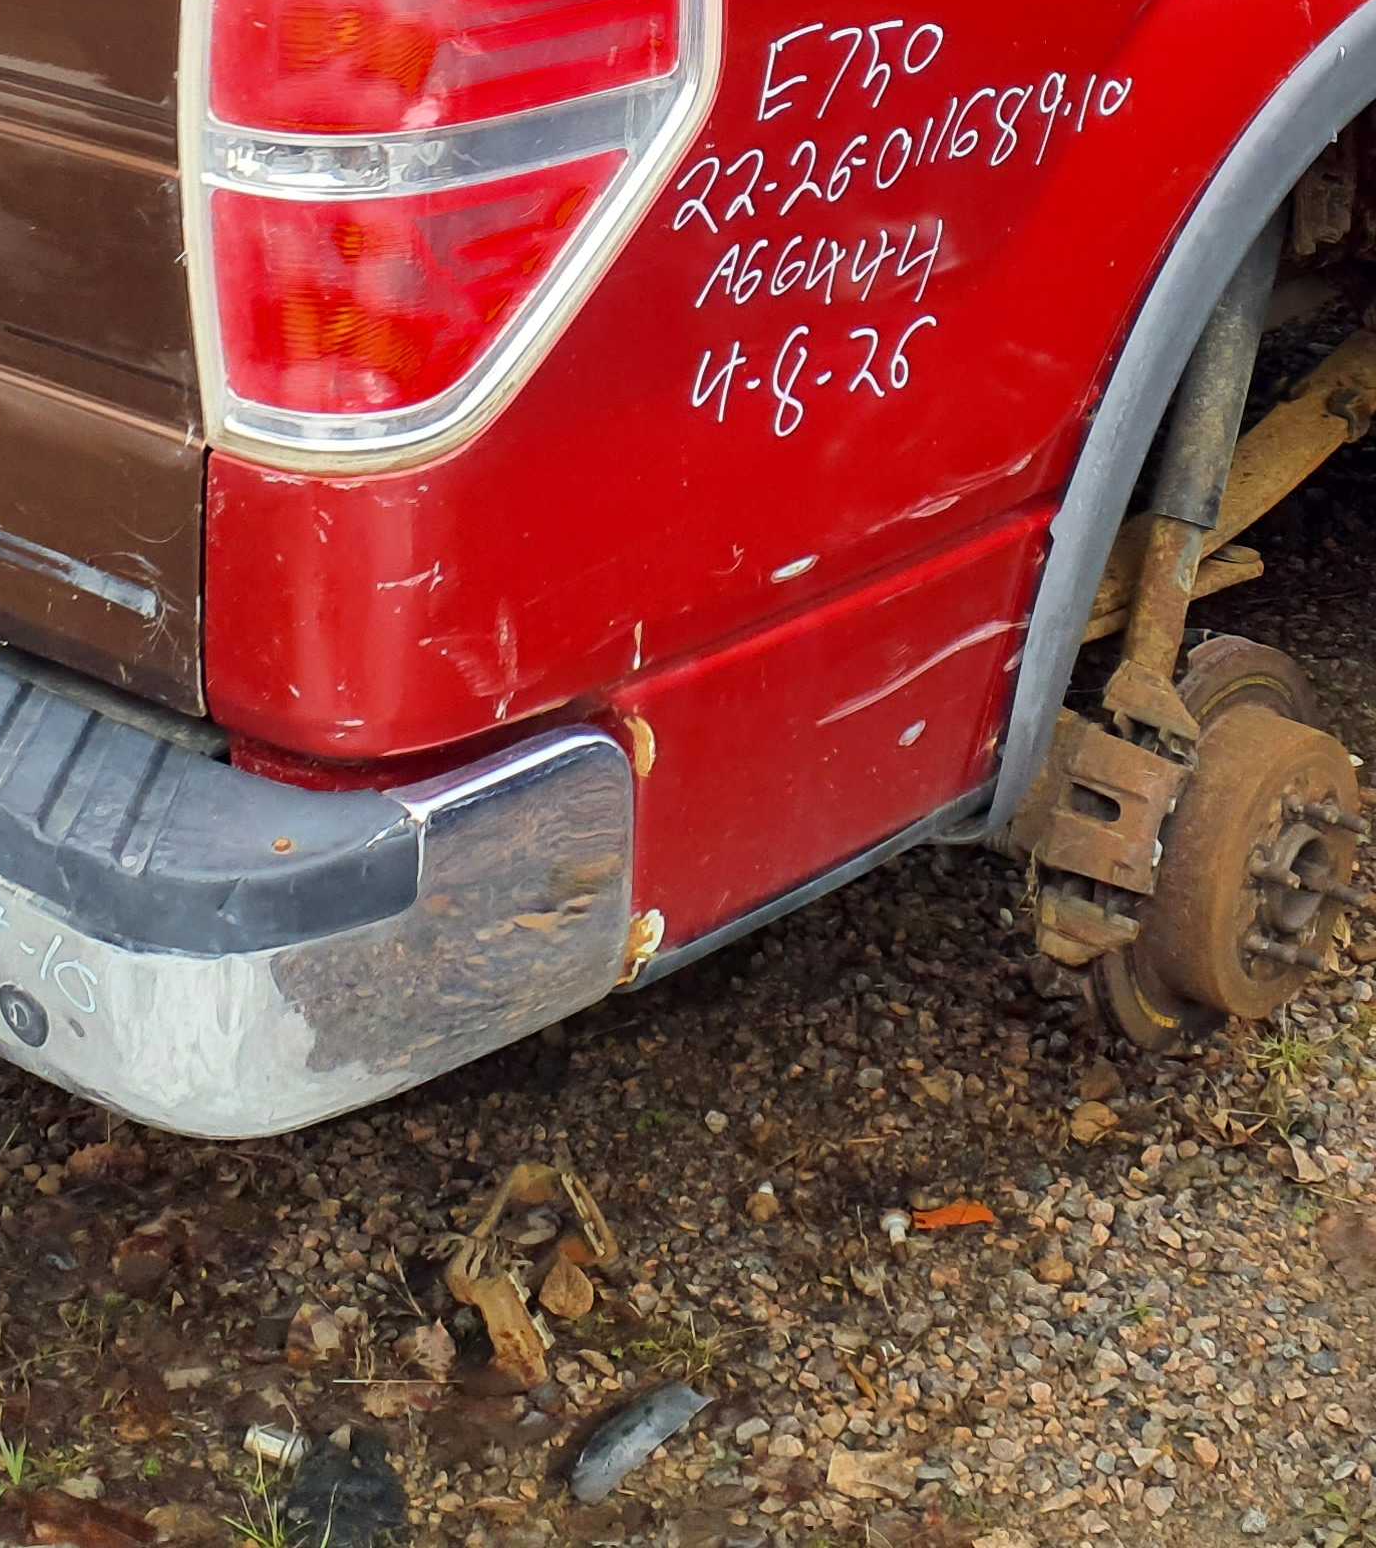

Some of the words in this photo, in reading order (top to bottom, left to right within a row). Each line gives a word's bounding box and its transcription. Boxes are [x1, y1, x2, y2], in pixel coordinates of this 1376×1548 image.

[757, 19, 944, 122] E750
[694, 219, 944, 309] A66444
[691, 315, 937, 438] 4-8-26
